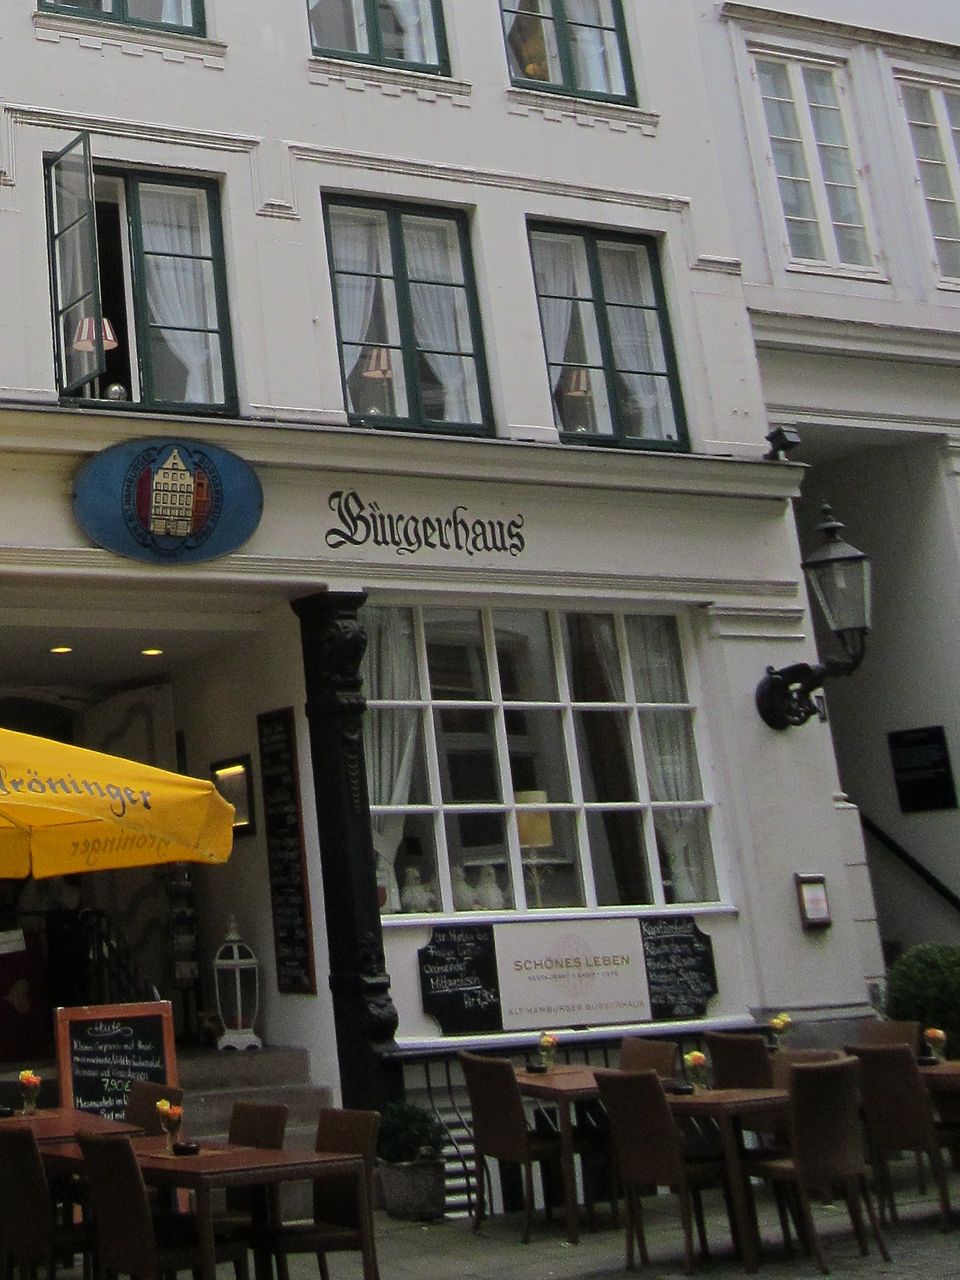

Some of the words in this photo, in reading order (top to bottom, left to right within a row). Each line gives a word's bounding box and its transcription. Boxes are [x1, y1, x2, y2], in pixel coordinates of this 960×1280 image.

[324, 491, 526, 556] Bürgerhaus
[514, 956, 581, 971] SCHÖNES
[585, 954, 630, 967] LEBEN
